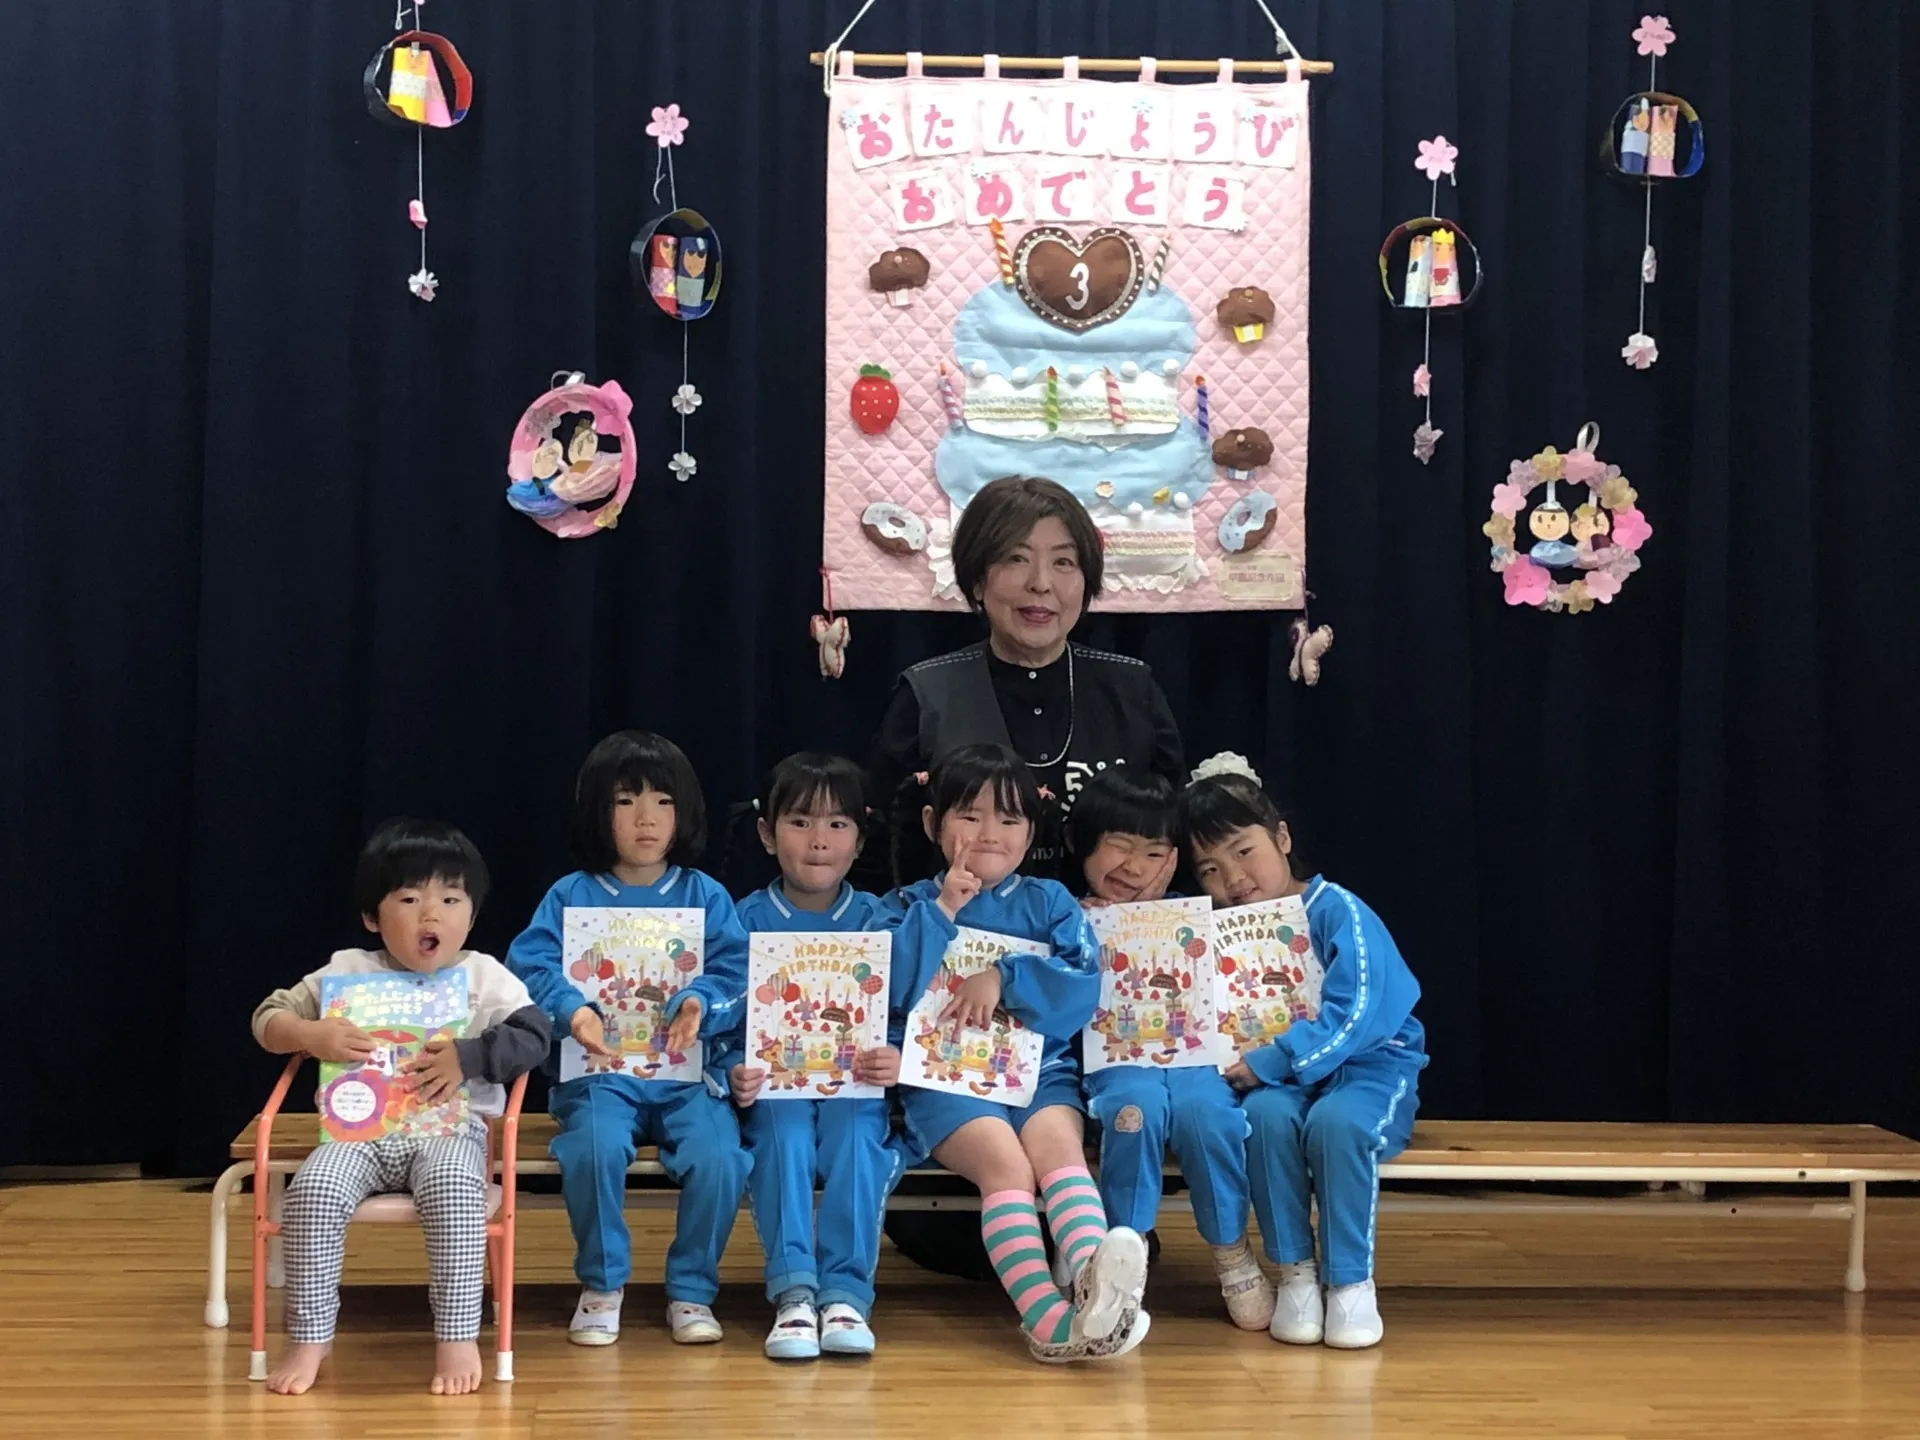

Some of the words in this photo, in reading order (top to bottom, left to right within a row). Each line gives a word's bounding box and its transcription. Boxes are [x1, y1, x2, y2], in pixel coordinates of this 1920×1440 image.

[856, 101, 1295, 160] おたんじょうび
[901, 170, 1230, 224] おめでとう
[1064, 262, 1090, 311] 3
[1215, 912, 1267, 933] HAPPY
[793, 942, 850, 958] HAPPY
